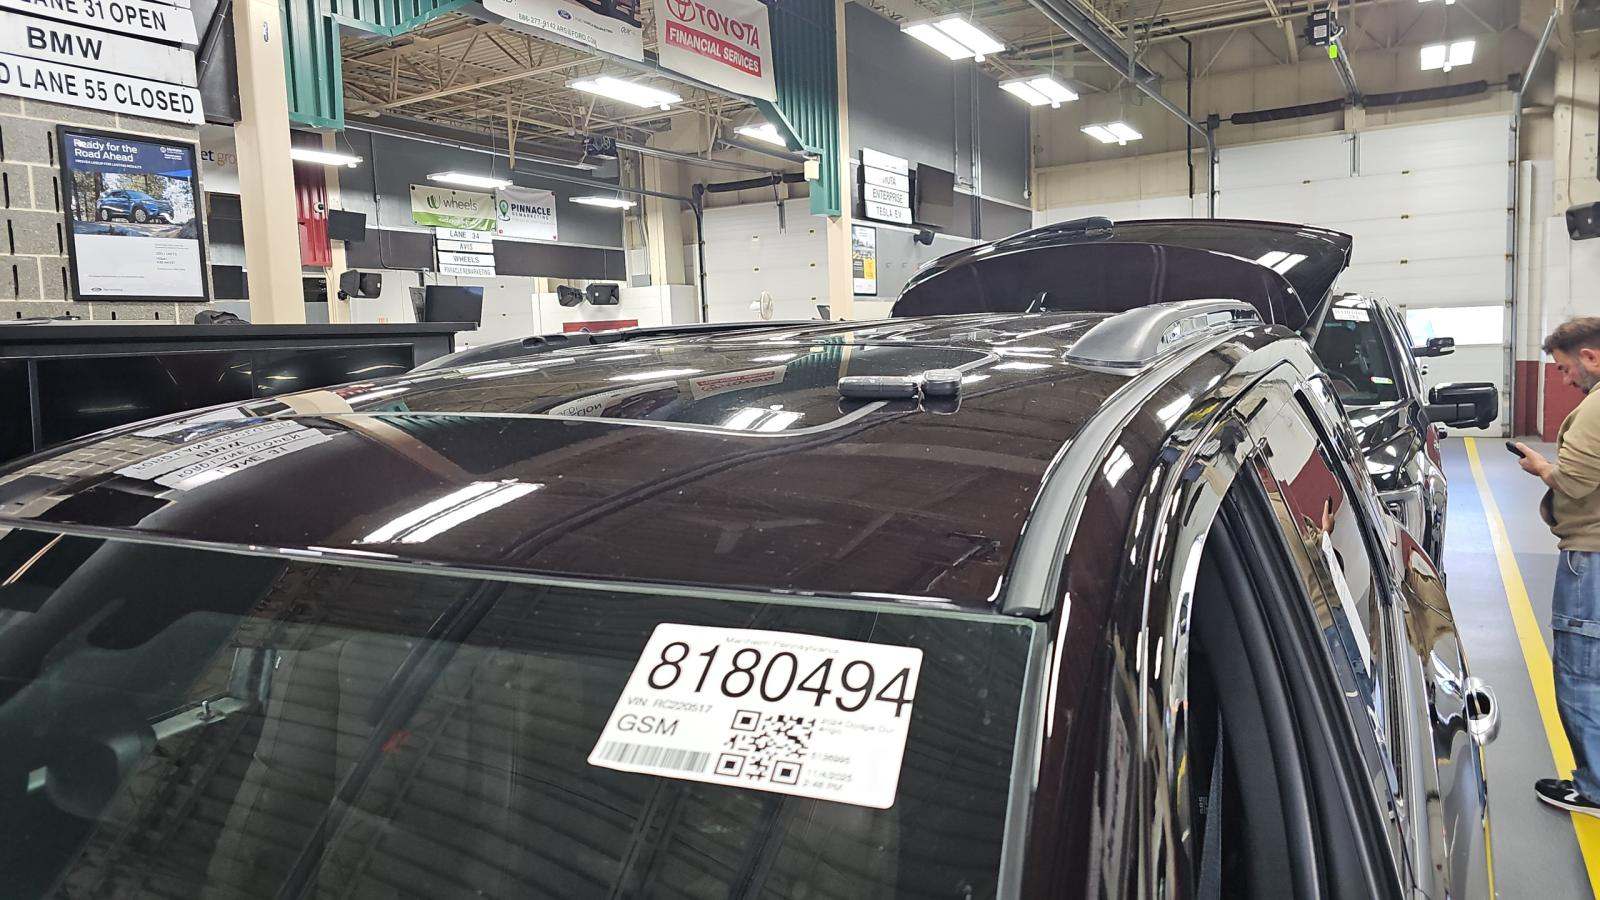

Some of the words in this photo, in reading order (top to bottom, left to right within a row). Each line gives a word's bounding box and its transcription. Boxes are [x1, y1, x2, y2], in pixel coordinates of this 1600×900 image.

[85, 0, 104, 19] 31
[109, 2, 167, 31] OPEN
[694, 2, 760, 49] TOYOTA
[26, 26, 103, 60] BMW
[669, 27, 721, 57] FINANCIAL
[722, 47, 759, 73] SERVICES
[17, 65, 79, 97] LANE
[84, 79, 108, 101] 55
[114, 83, 195, 114] CLOSED
[73, 138, 105, 153] Ready
[106, 143, 121, 152] for
[121, 144, 138, 155] the
[74, 148, 101, 159] Road
[102, 151, 134, 163] Ahead
[442, 196, 478, 211] wheels
[872, 188, 903, 204] ENTERPRISE
[511, 203, 552, 216] PINNACLE
[876, 206, 893, 217] TESLA
[449, 230, 467, 238] LANE
[452, 255, 480, 263] WHEELS
[648, 641, 913, 717] 8180494
[617, 713, 679, 736] GSM
